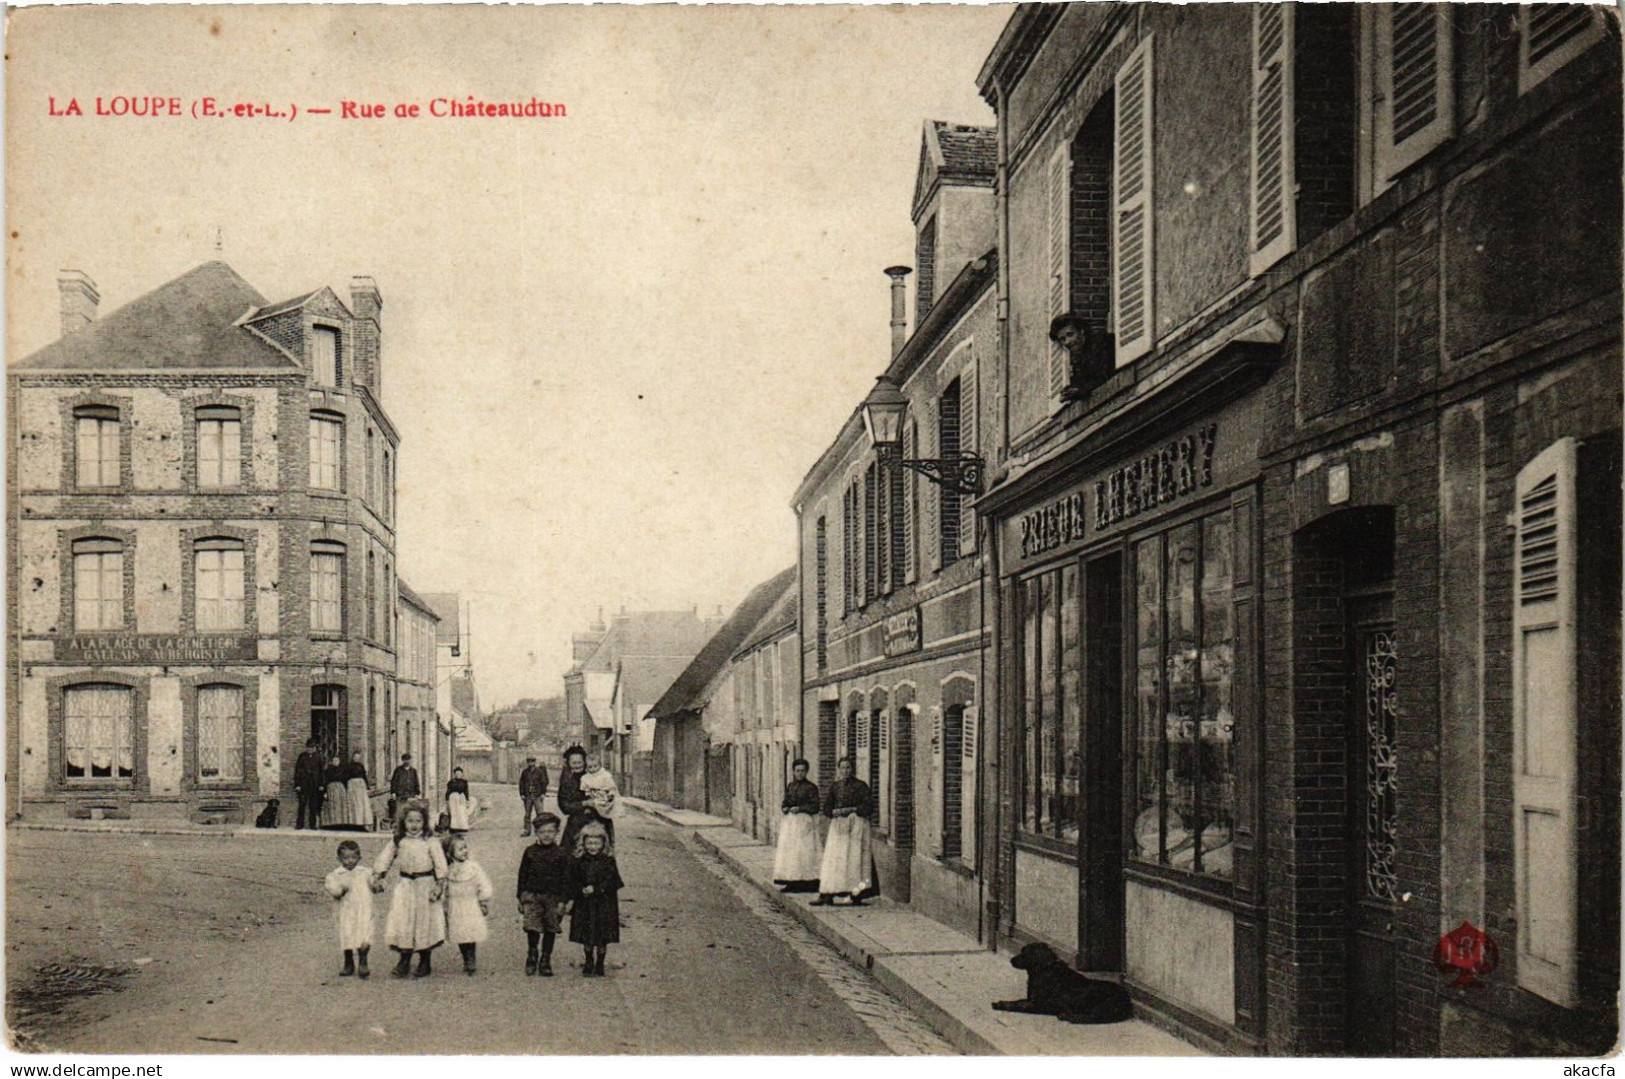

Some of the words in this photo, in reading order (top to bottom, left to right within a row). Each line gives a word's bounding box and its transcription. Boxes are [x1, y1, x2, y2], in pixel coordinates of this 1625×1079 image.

[1020, 491, 1085, 559] PRIEUR
[98, 638, 134, 650] PLACE
[137, 638, 152, 650] DE
[156, 638, 174, 650] LA
